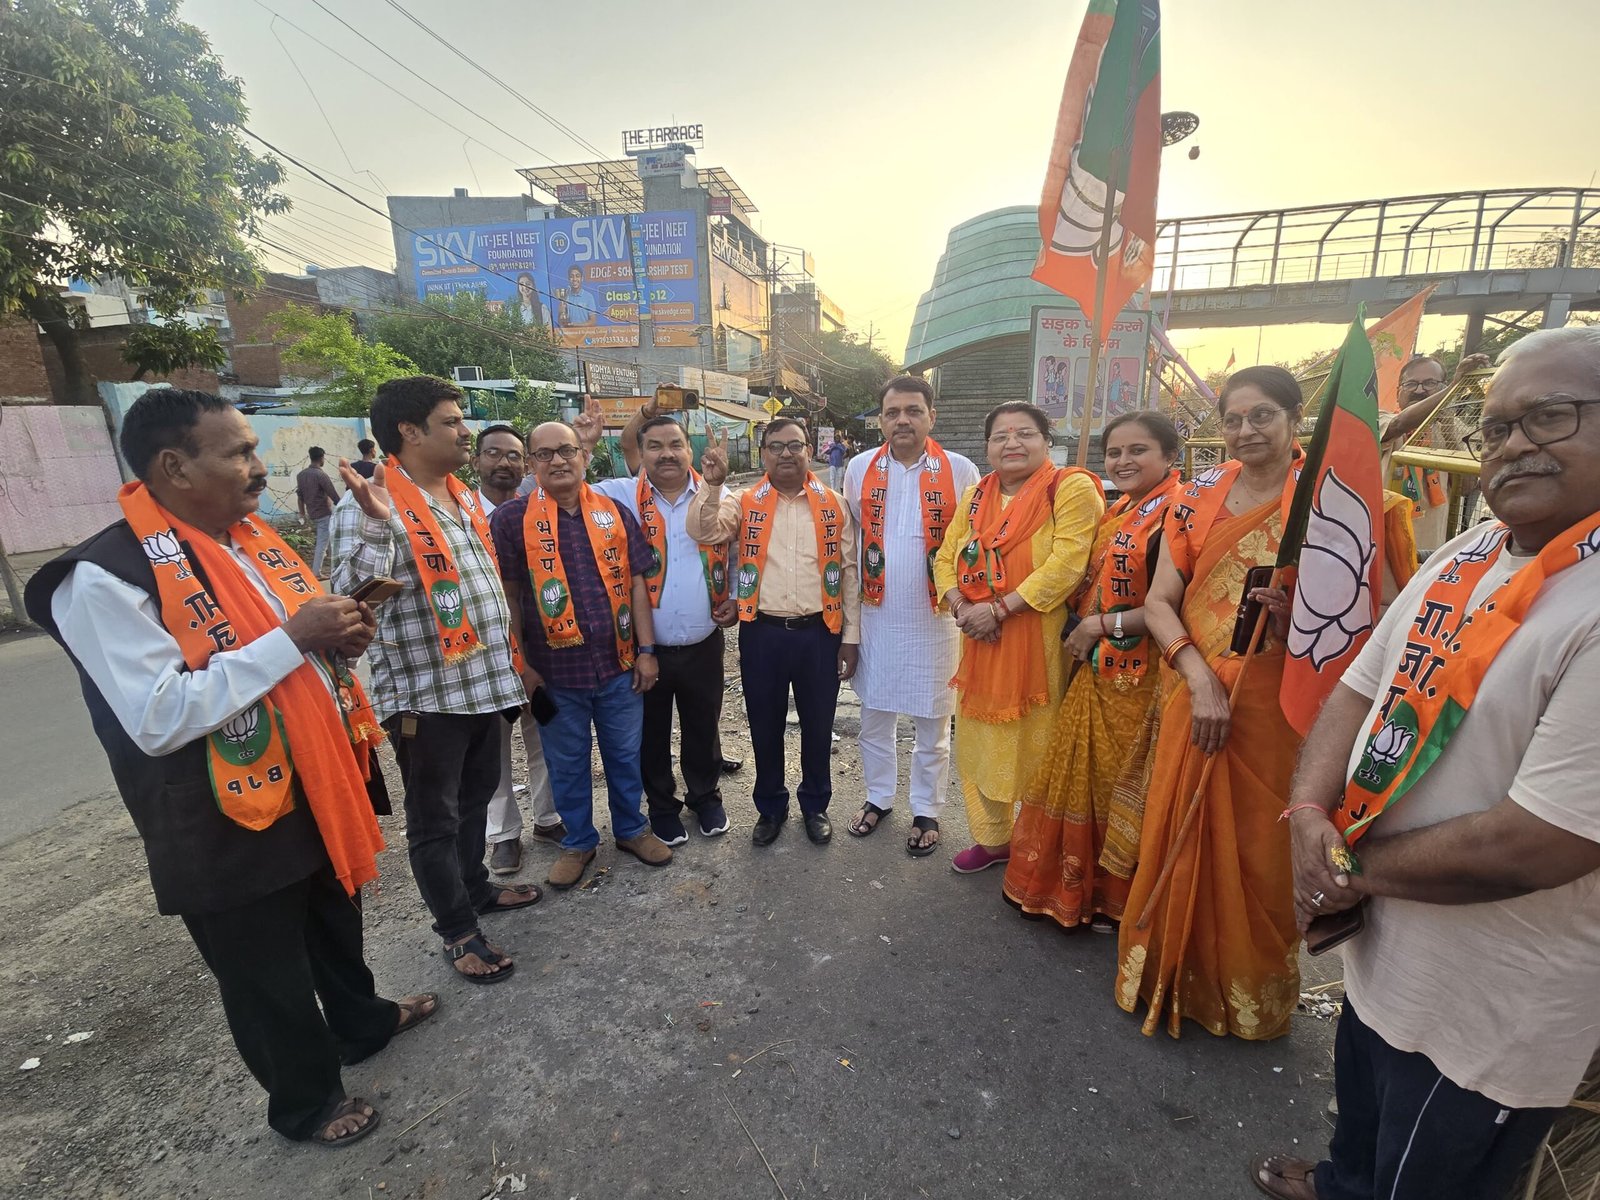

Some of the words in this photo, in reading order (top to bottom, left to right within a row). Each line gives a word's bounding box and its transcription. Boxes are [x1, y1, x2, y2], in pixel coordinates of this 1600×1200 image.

[666, 222, 687, 237] NEET
[477, 234, 507, 248] IIT-JEE
[516, 232, 540, 245] NEET
[572, 218, 627, 261] SKV
[415, 231, 476, 266] SKV
[488, 249, 533, 259] FOUNDATION
[645, 243, 681, 255] OUNDATION
[590, 266, 611, 278] EDGE
[670, 264, 689, 275] TEST
[456, 290, 476, 301] SV
[606, 290, 630, 301] Class
[656, 290, 666, 300] 12
[1041, 318, 1081, 334] सड़क
[1063, 334, 1079, 348] के
[612, 367, 638, 378] VENTURES
[963, 572, 984, 584] BJP
[1105, 657, 1142, 669] BJP
